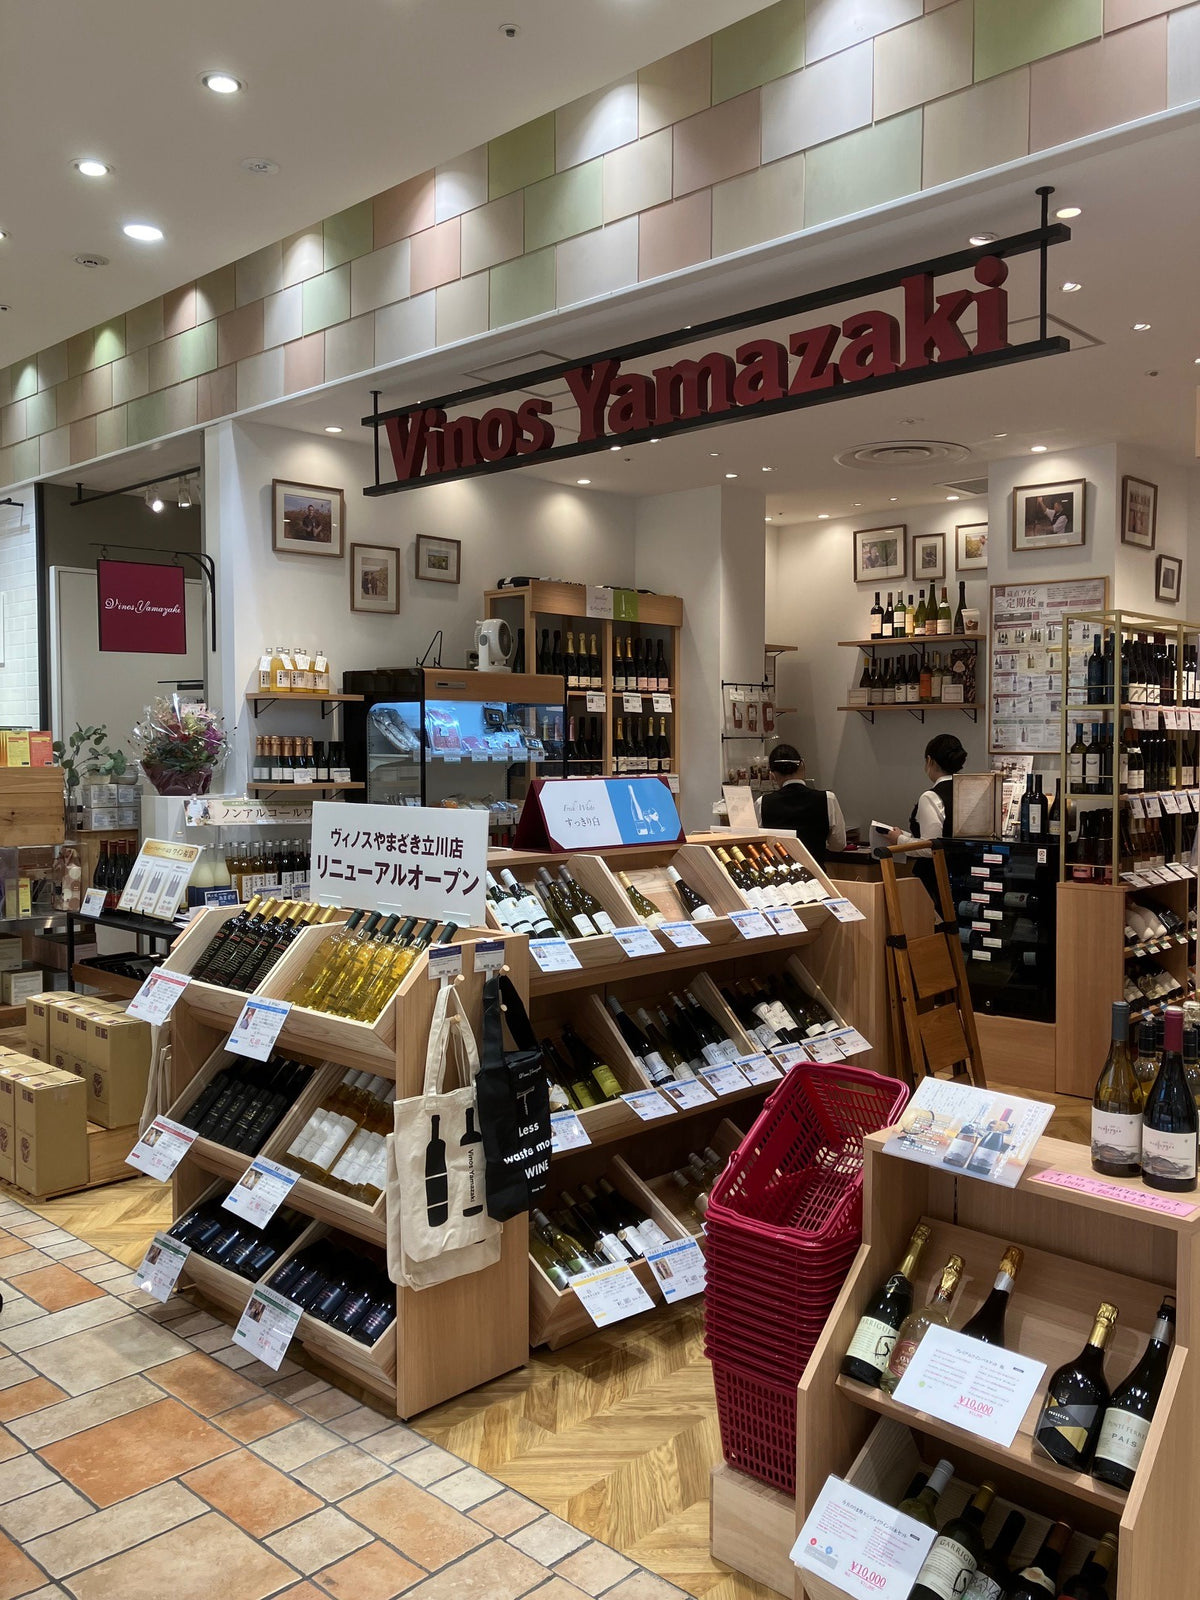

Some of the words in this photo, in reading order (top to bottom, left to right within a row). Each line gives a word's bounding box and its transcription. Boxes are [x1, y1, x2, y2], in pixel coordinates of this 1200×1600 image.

[384, 394, 556, 481] Vinos
[563, 257, 1010, 443] Yamazaki
[104, 597, 134, 611] Vinos
[135, 600, 181, 616] Yamazaki
[1005, 596, 1037, 609] 定期便
[330, 828, 464, 859] ヴィノスやまざき立川店
[317, 854, 480, 896] リニューアルオープン
[518, 1122, 540, 1138] Less
[503, 1147, 534, 1165] waste
[525, 1159, 550, 1180] WINE
[468, 1171, 476, 1203] Yamazaki
[958, 1395, 994, 1415] ¥10,000
[847, 1560, 887, 1589] ¥10,000
